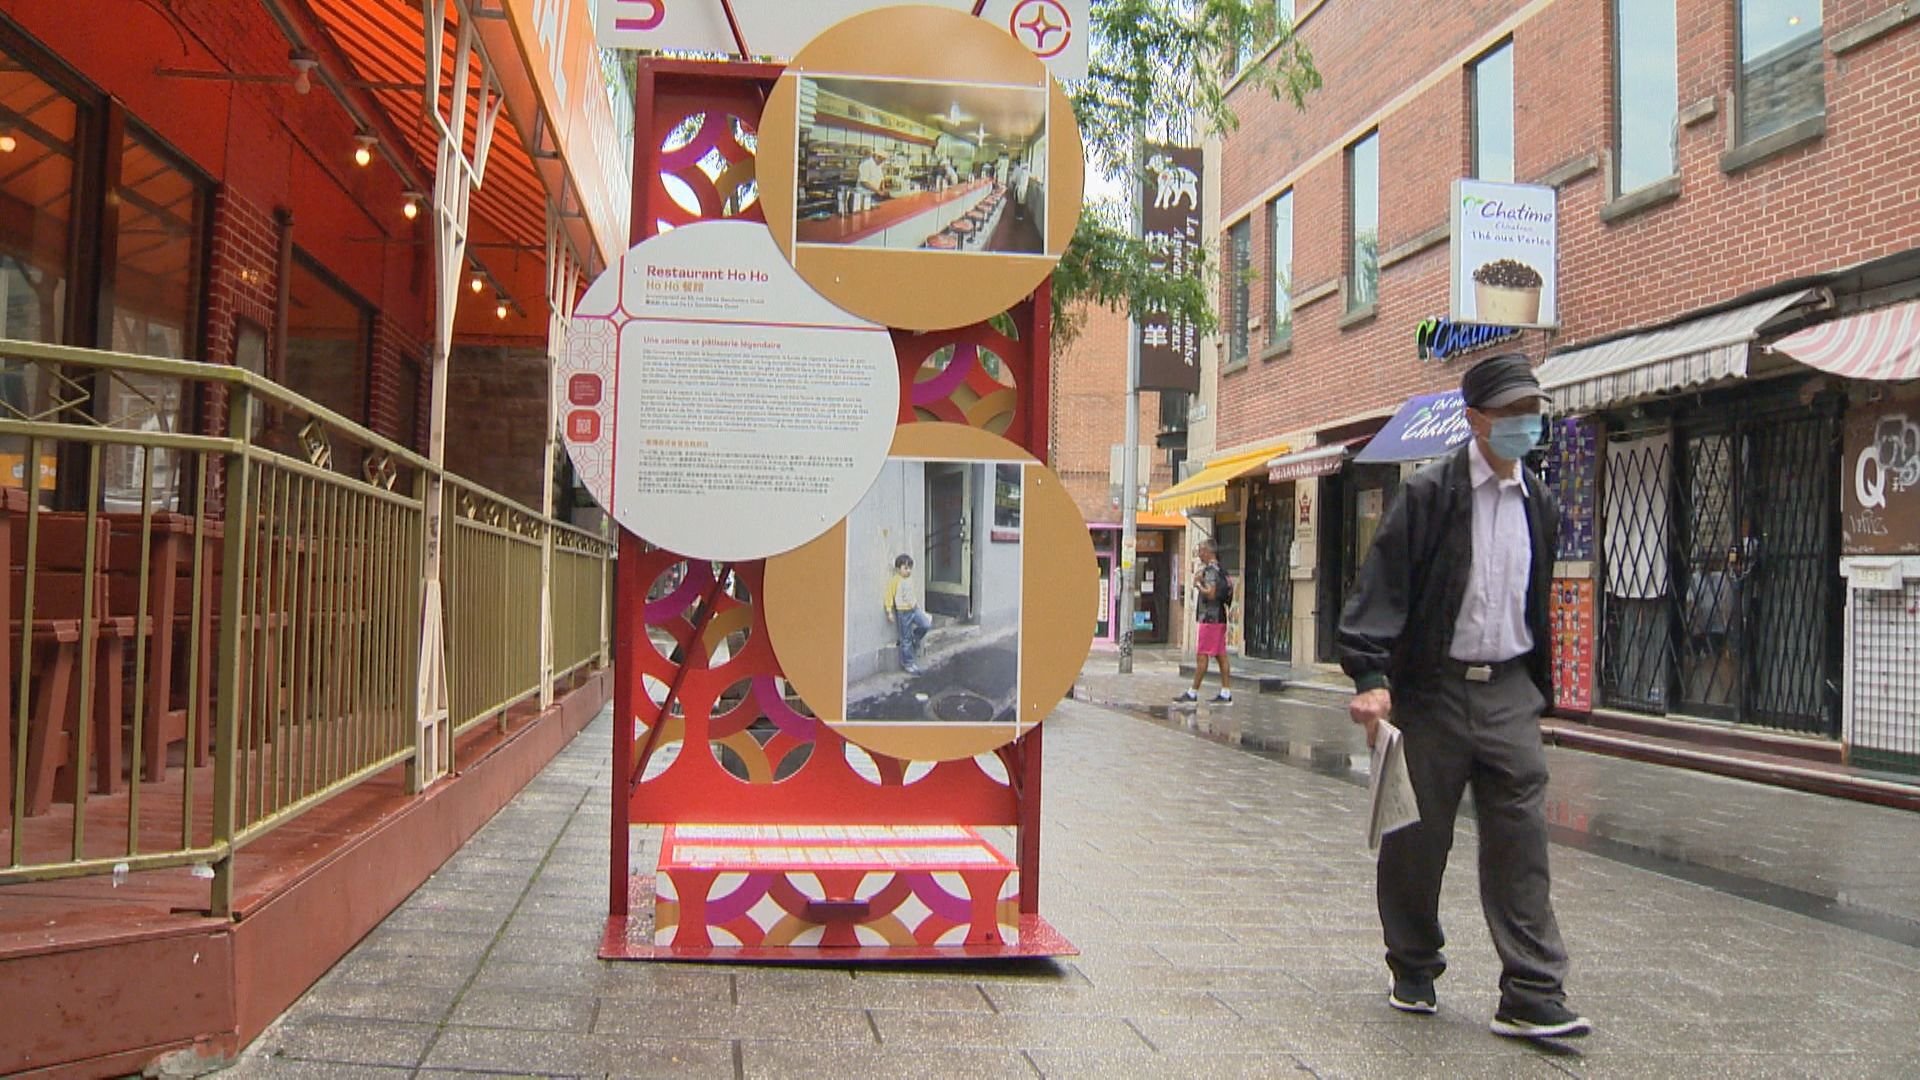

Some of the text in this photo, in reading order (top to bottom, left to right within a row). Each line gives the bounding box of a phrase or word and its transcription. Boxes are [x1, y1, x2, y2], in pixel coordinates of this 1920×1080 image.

[1480, 200, 1553, 223] Chatime
[646, 264, 769, 282] Restaurant Ho Ho
[646, 280, 662, 291] Ho
[664, 281, 680, 292] Ho
